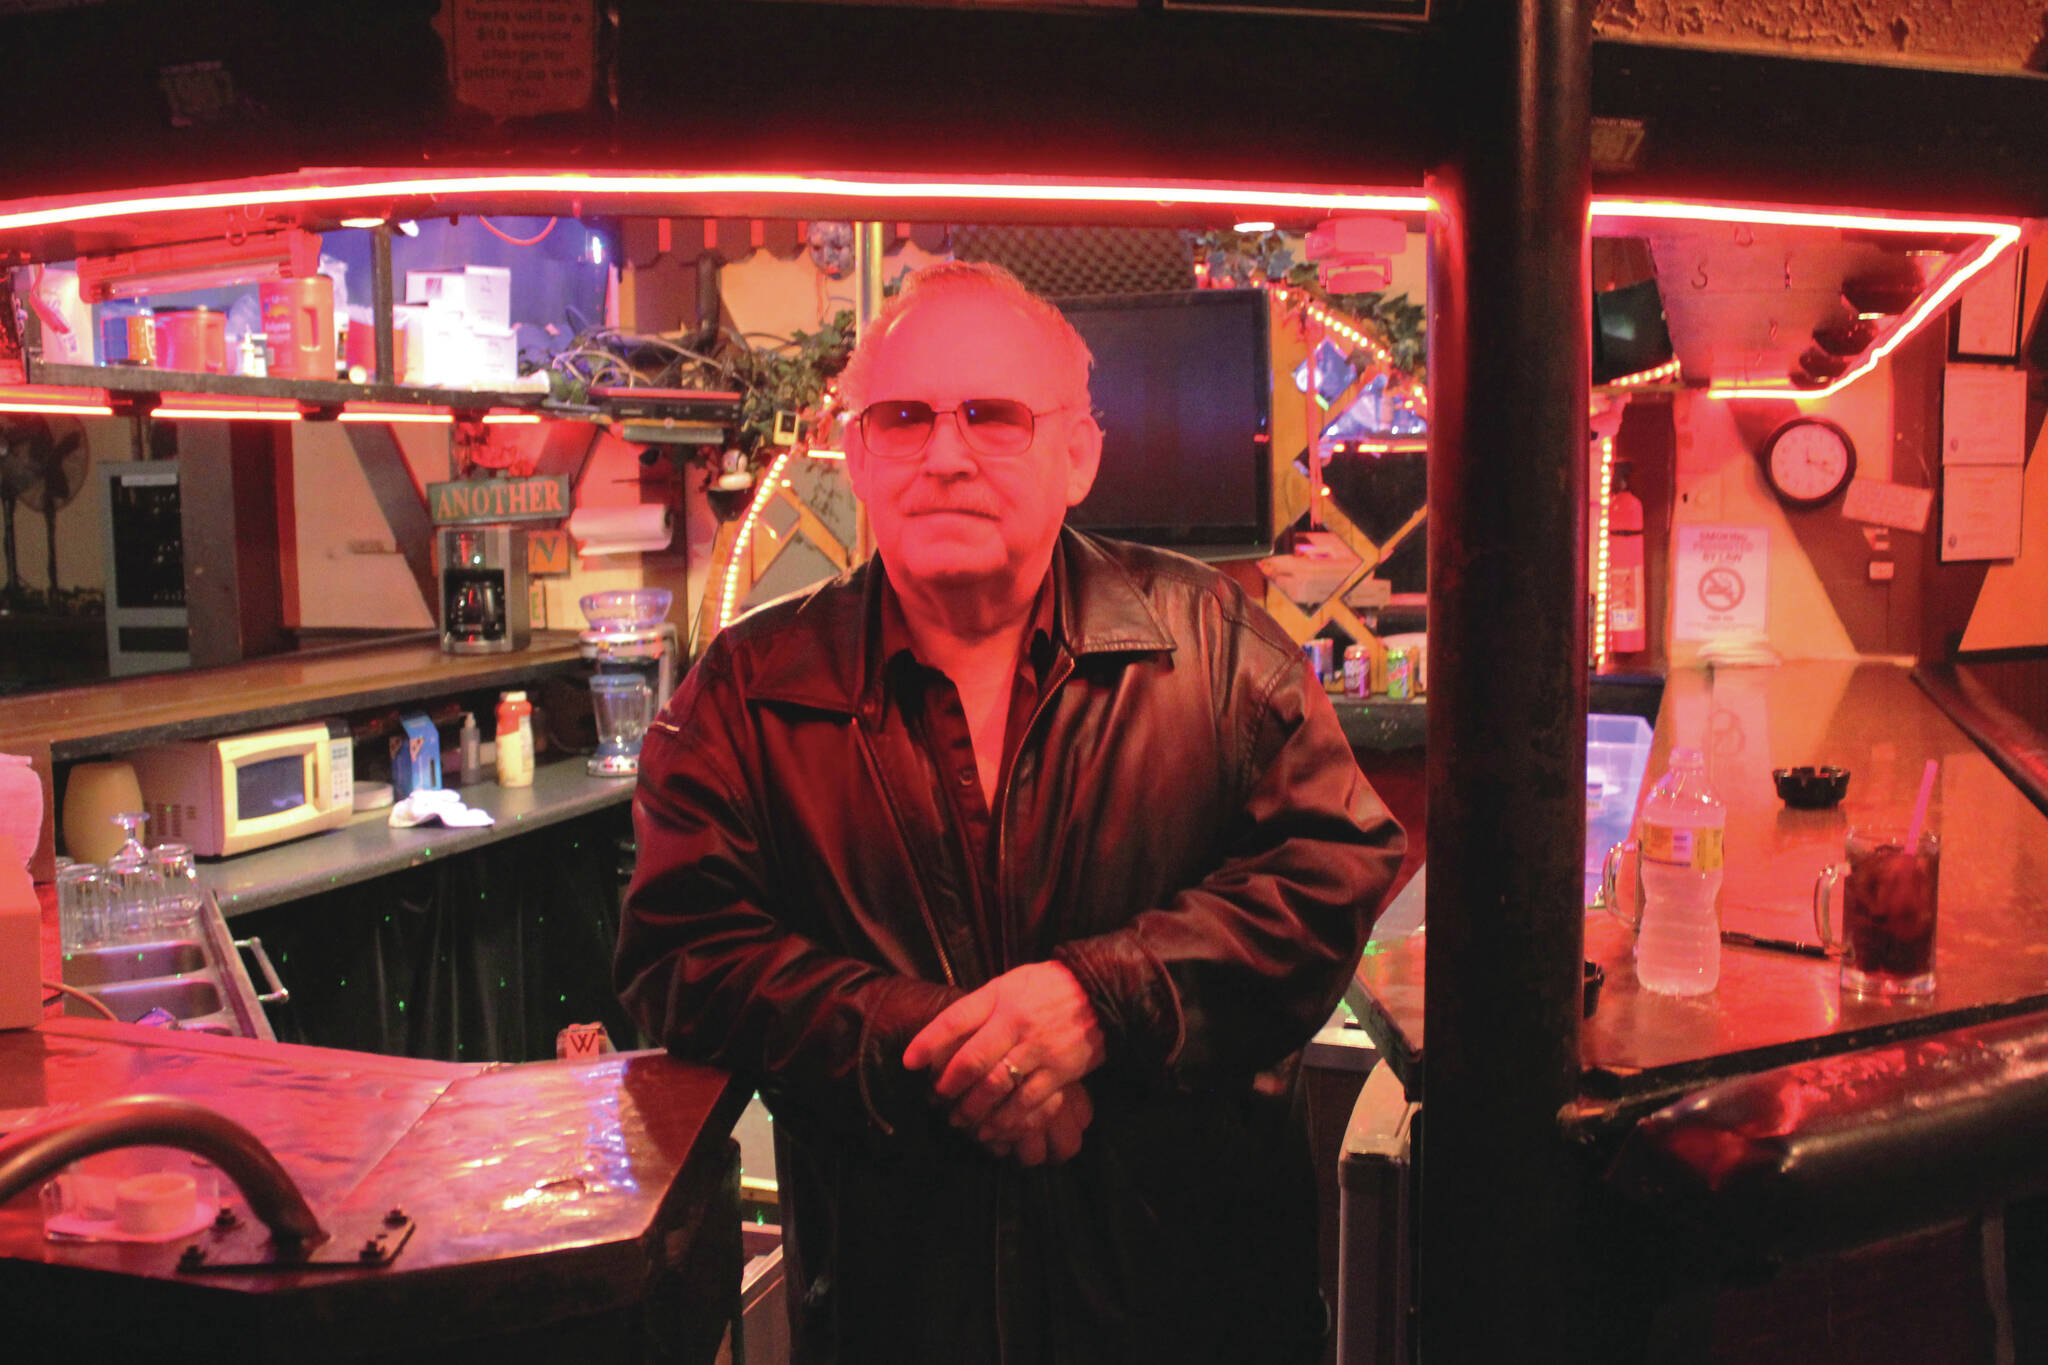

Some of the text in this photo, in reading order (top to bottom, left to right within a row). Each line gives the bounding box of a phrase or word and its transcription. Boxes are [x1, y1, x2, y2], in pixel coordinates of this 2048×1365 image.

[437, 480, 562, 519] ANOTHER
[532, 537, 559, 565] N
[569, 1032, 597, 1053] W
